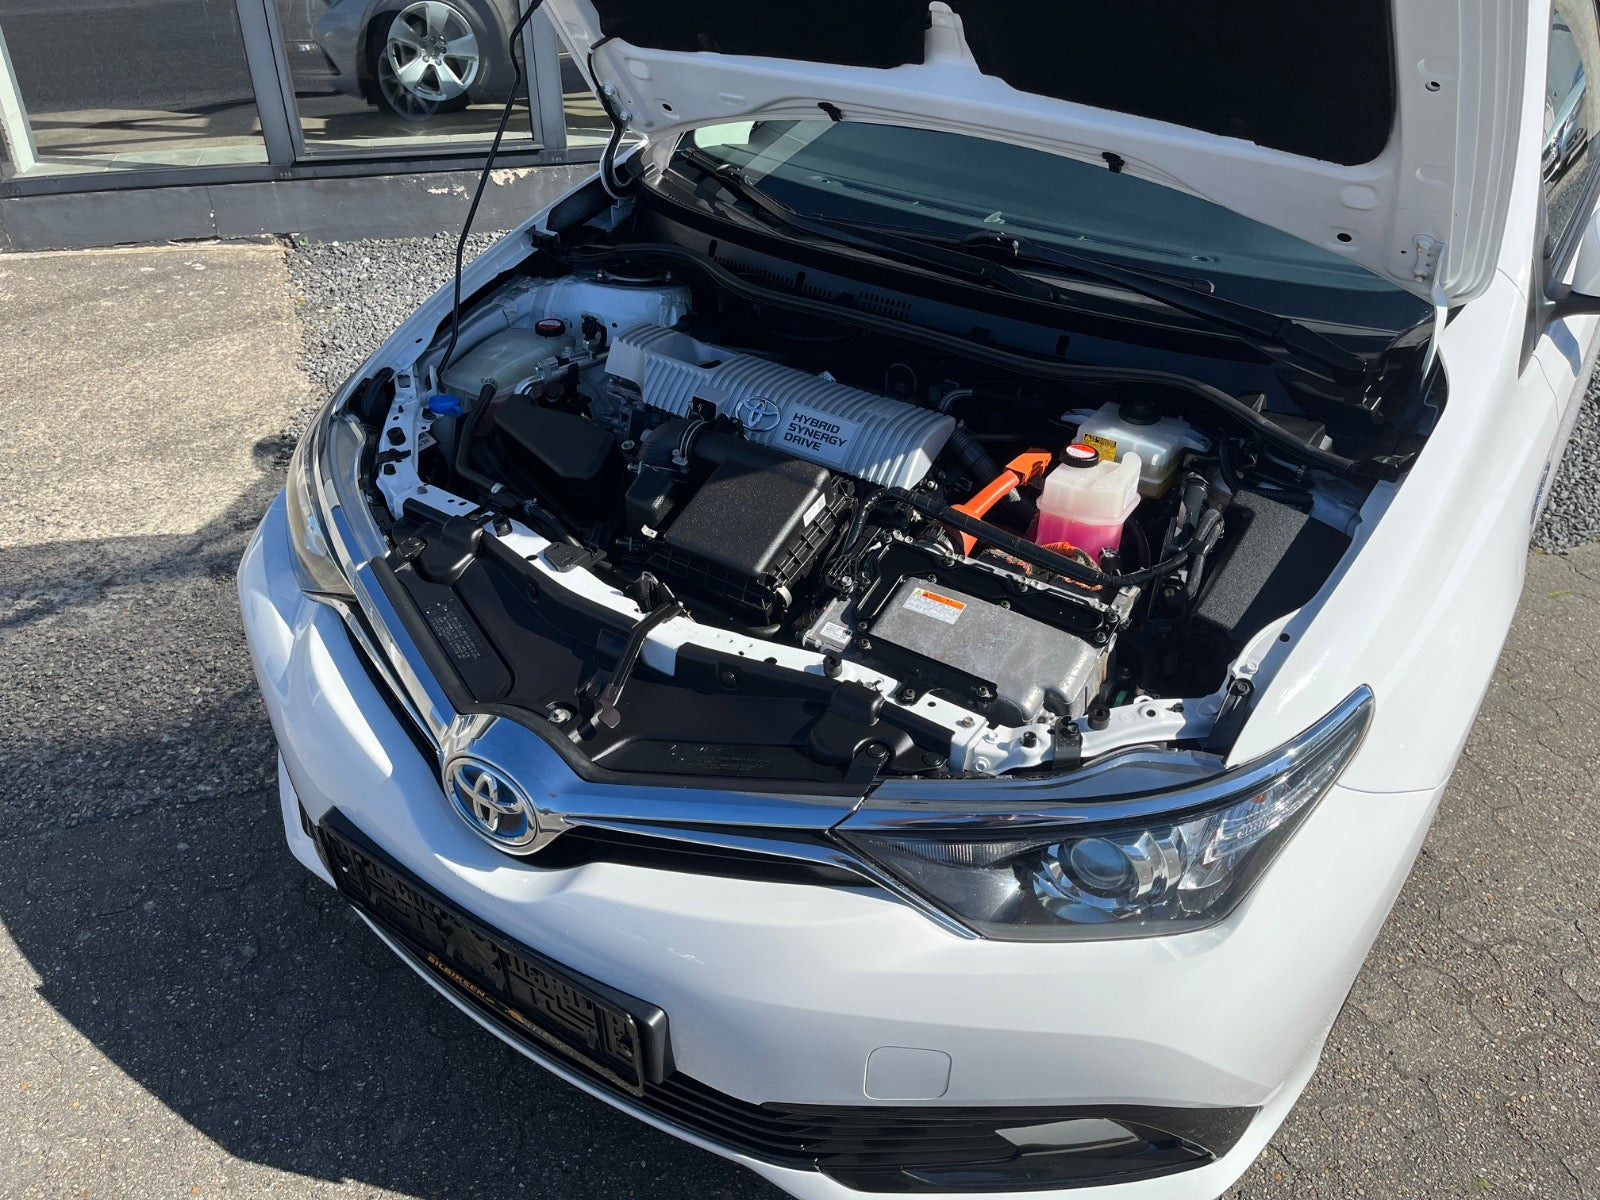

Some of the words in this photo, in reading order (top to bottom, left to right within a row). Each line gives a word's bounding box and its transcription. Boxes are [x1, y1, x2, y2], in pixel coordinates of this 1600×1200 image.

[793, 413, 840, 434] HYBRID
[784, 433, 822, 451] DRIVE
[788, 423, 847, 447] SYNERGY
